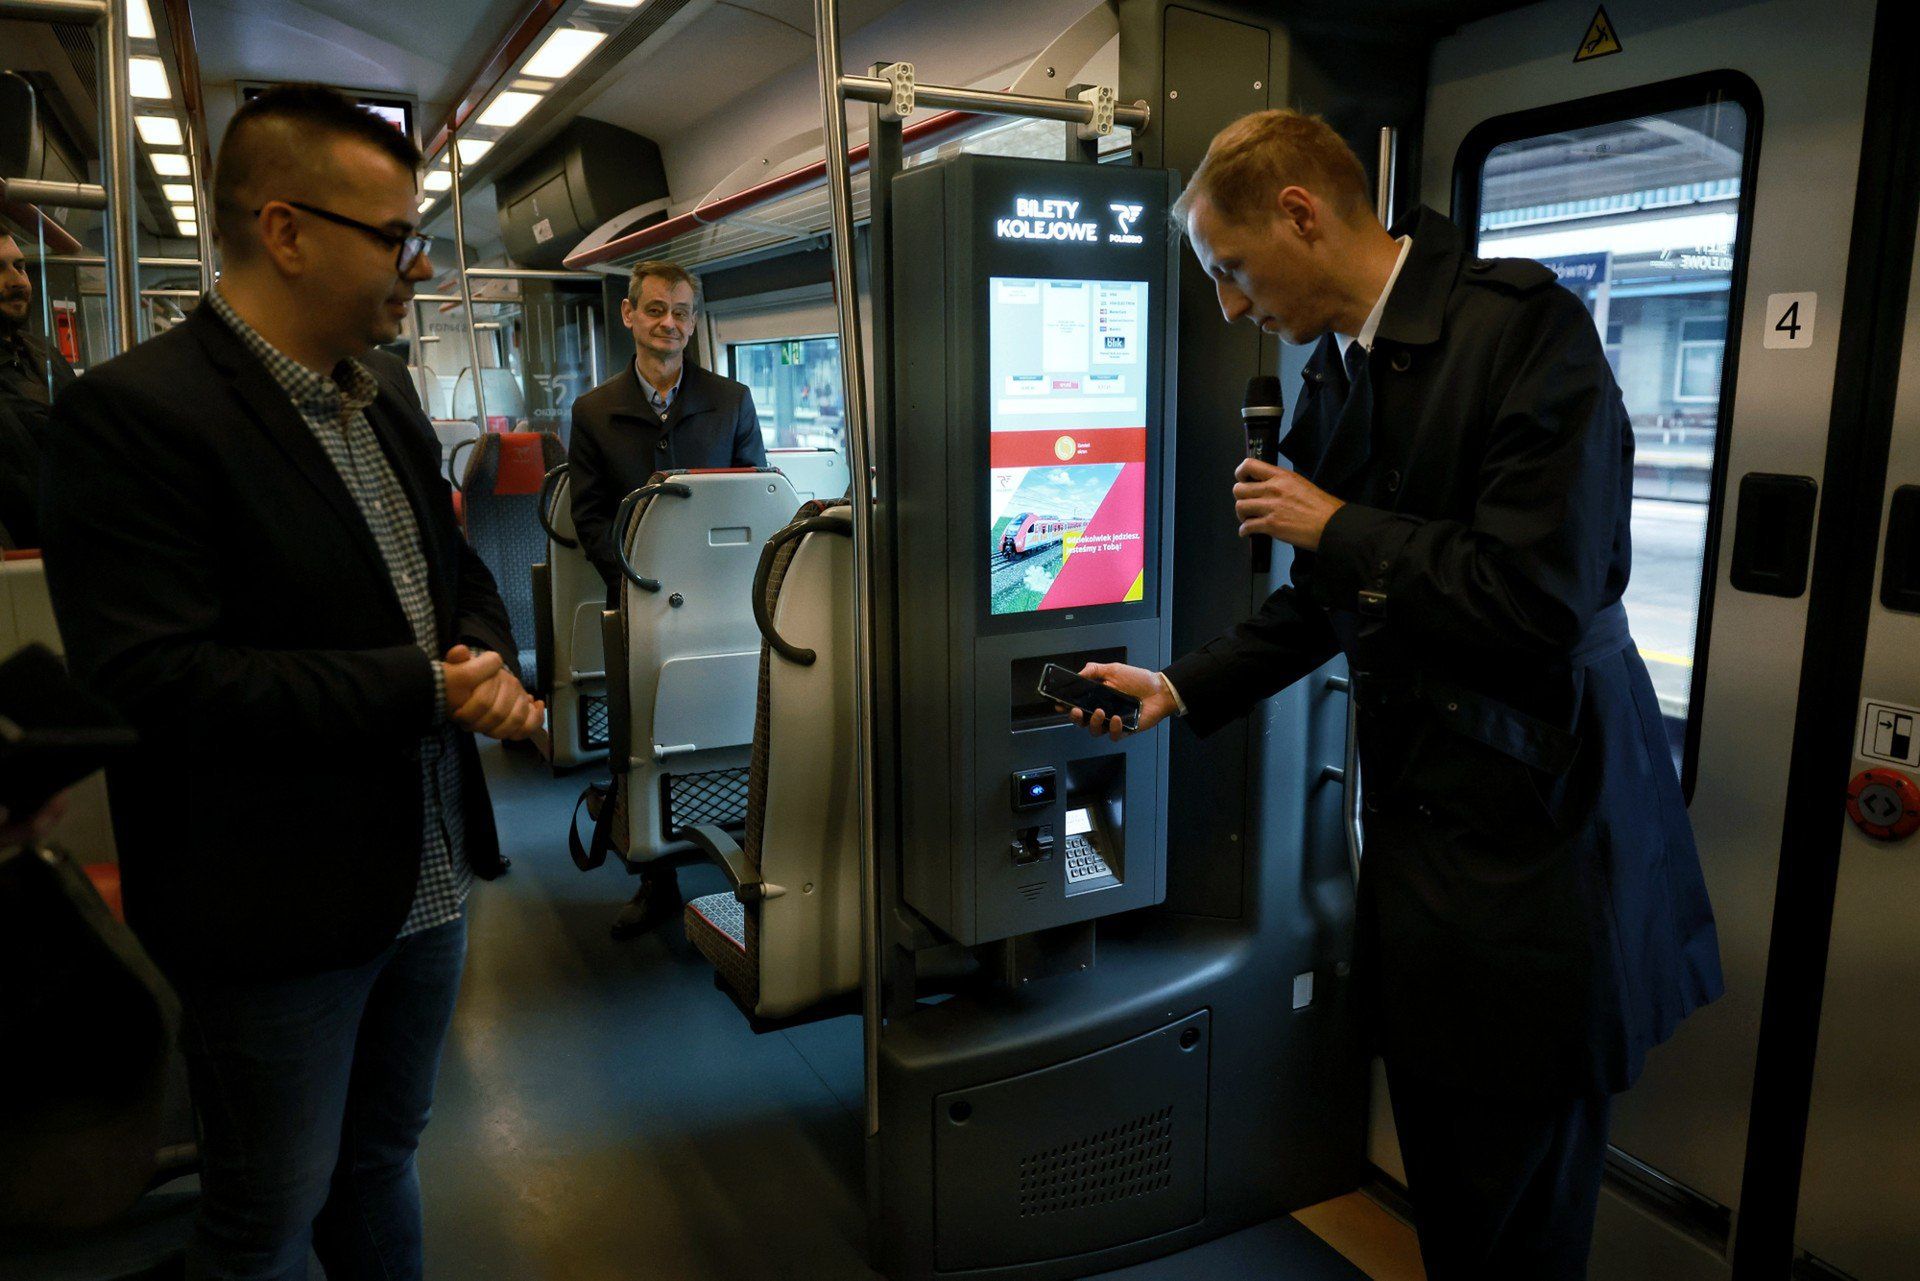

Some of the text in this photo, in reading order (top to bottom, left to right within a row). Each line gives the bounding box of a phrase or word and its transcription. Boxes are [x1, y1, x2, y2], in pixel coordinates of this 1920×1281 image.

[1016, 198, 1079, 219] BILETY
[997, 219, 1097, 242] KOLEJOWE
[1775, 301, 1801, 340] 4
